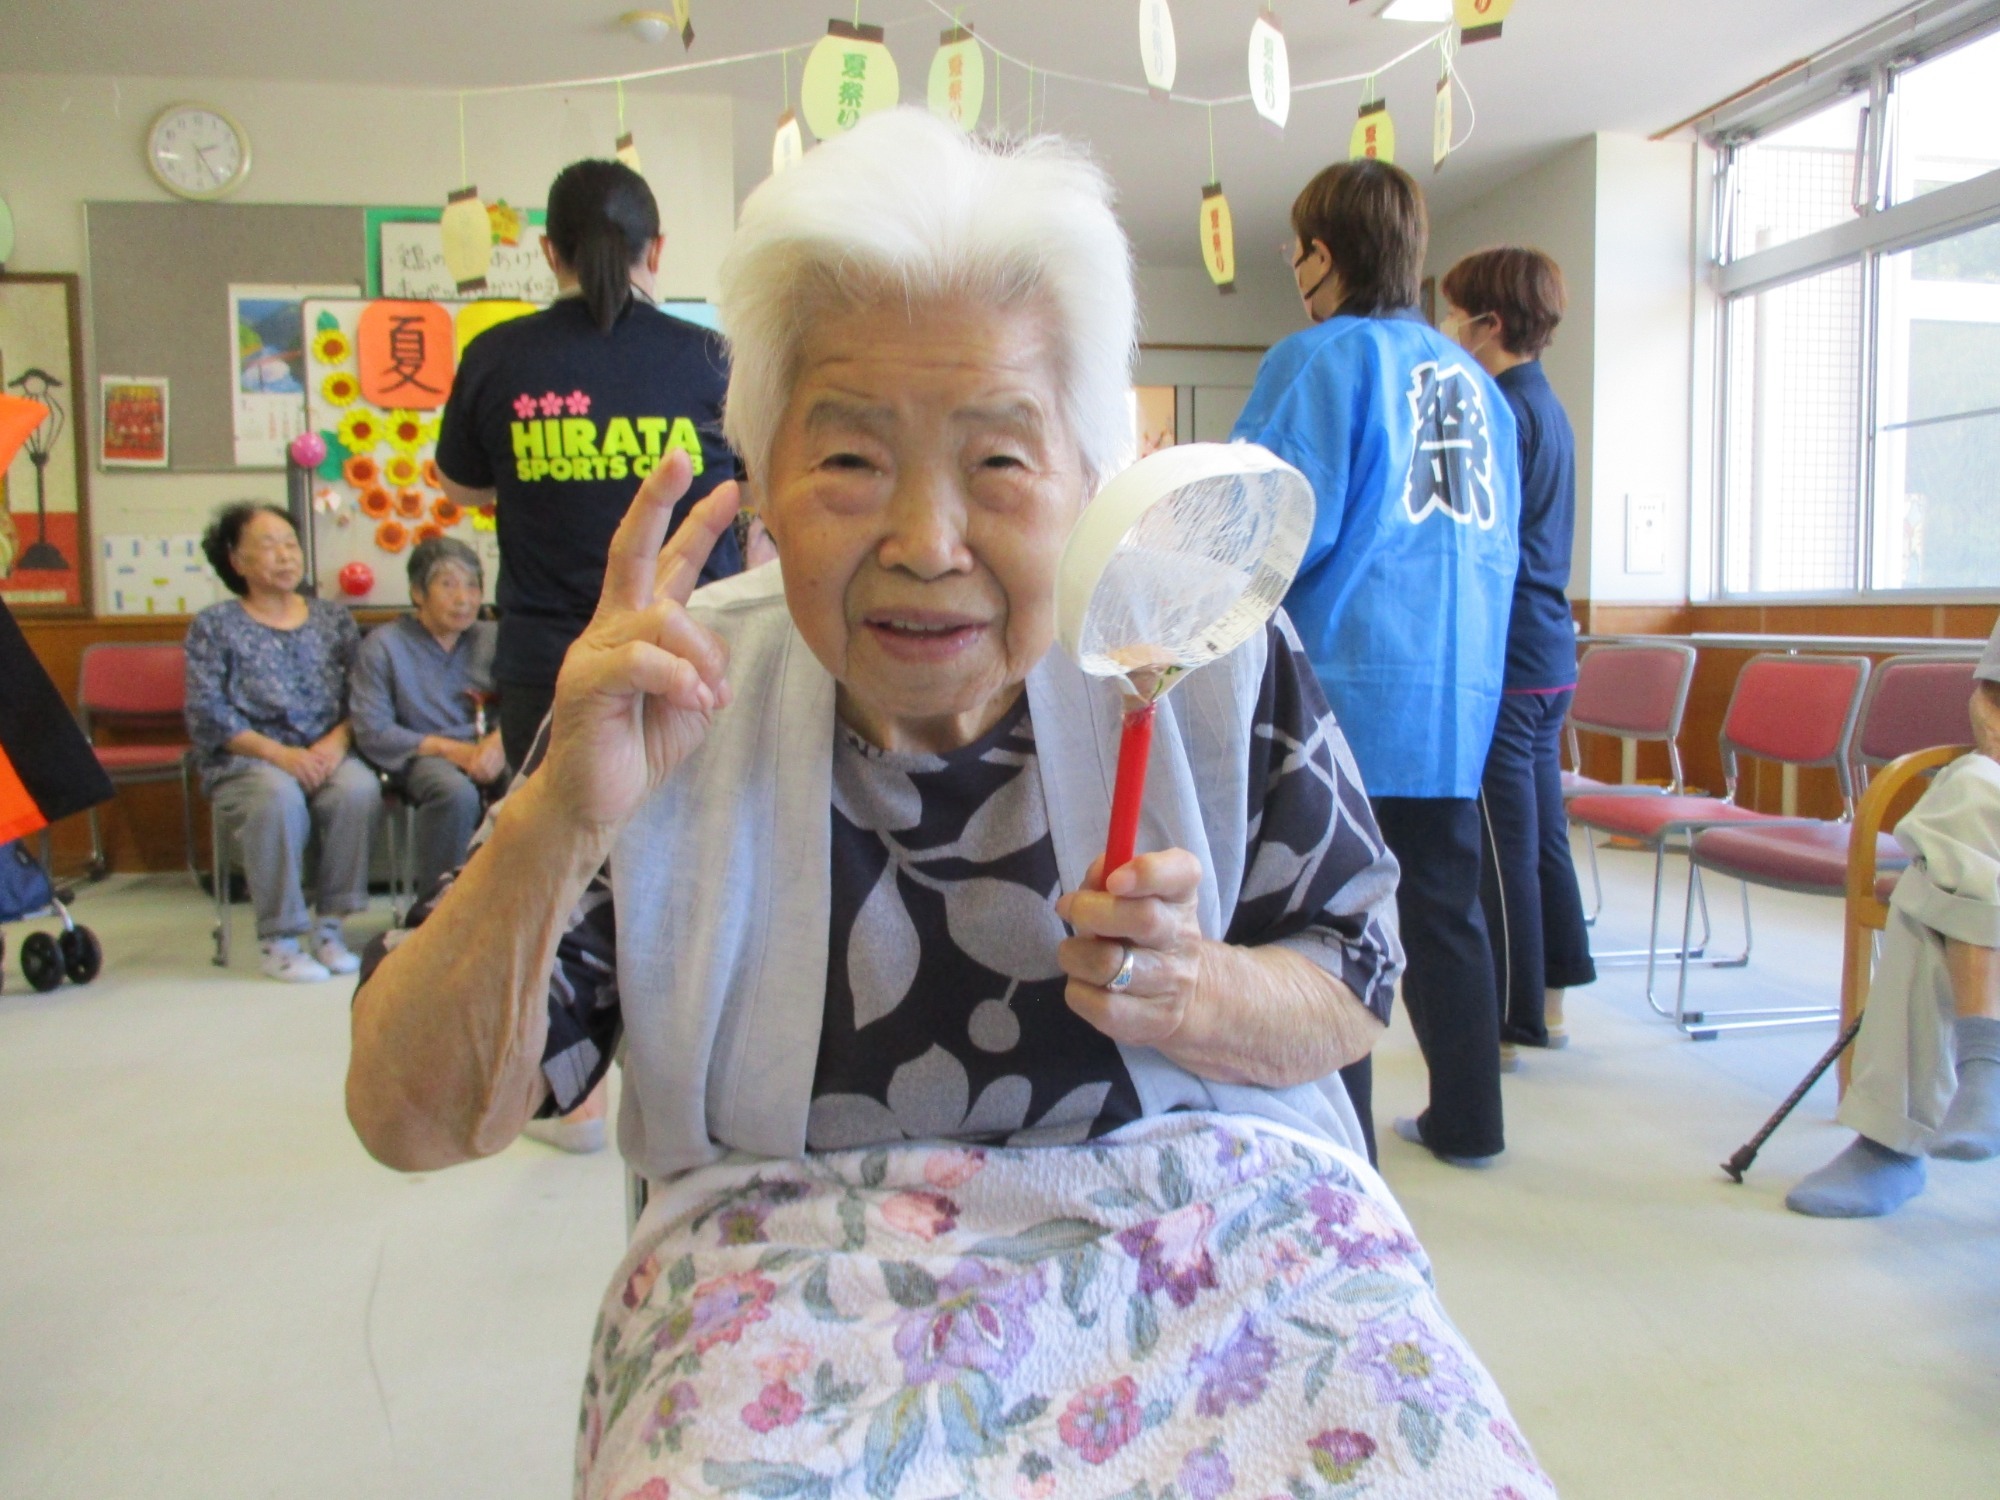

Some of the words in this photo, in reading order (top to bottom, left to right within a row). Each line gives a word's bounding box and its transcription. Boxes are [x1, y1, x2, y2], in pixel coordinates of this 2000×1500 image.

[837, 53, 868, 129] 夏祭り
[378, 315, 444, 394] 夏
[511, 417, 702, 459] HIRATA
[516, 455, 629, 482] SPORTS
[1403, 362, 1494, 529] 祭
